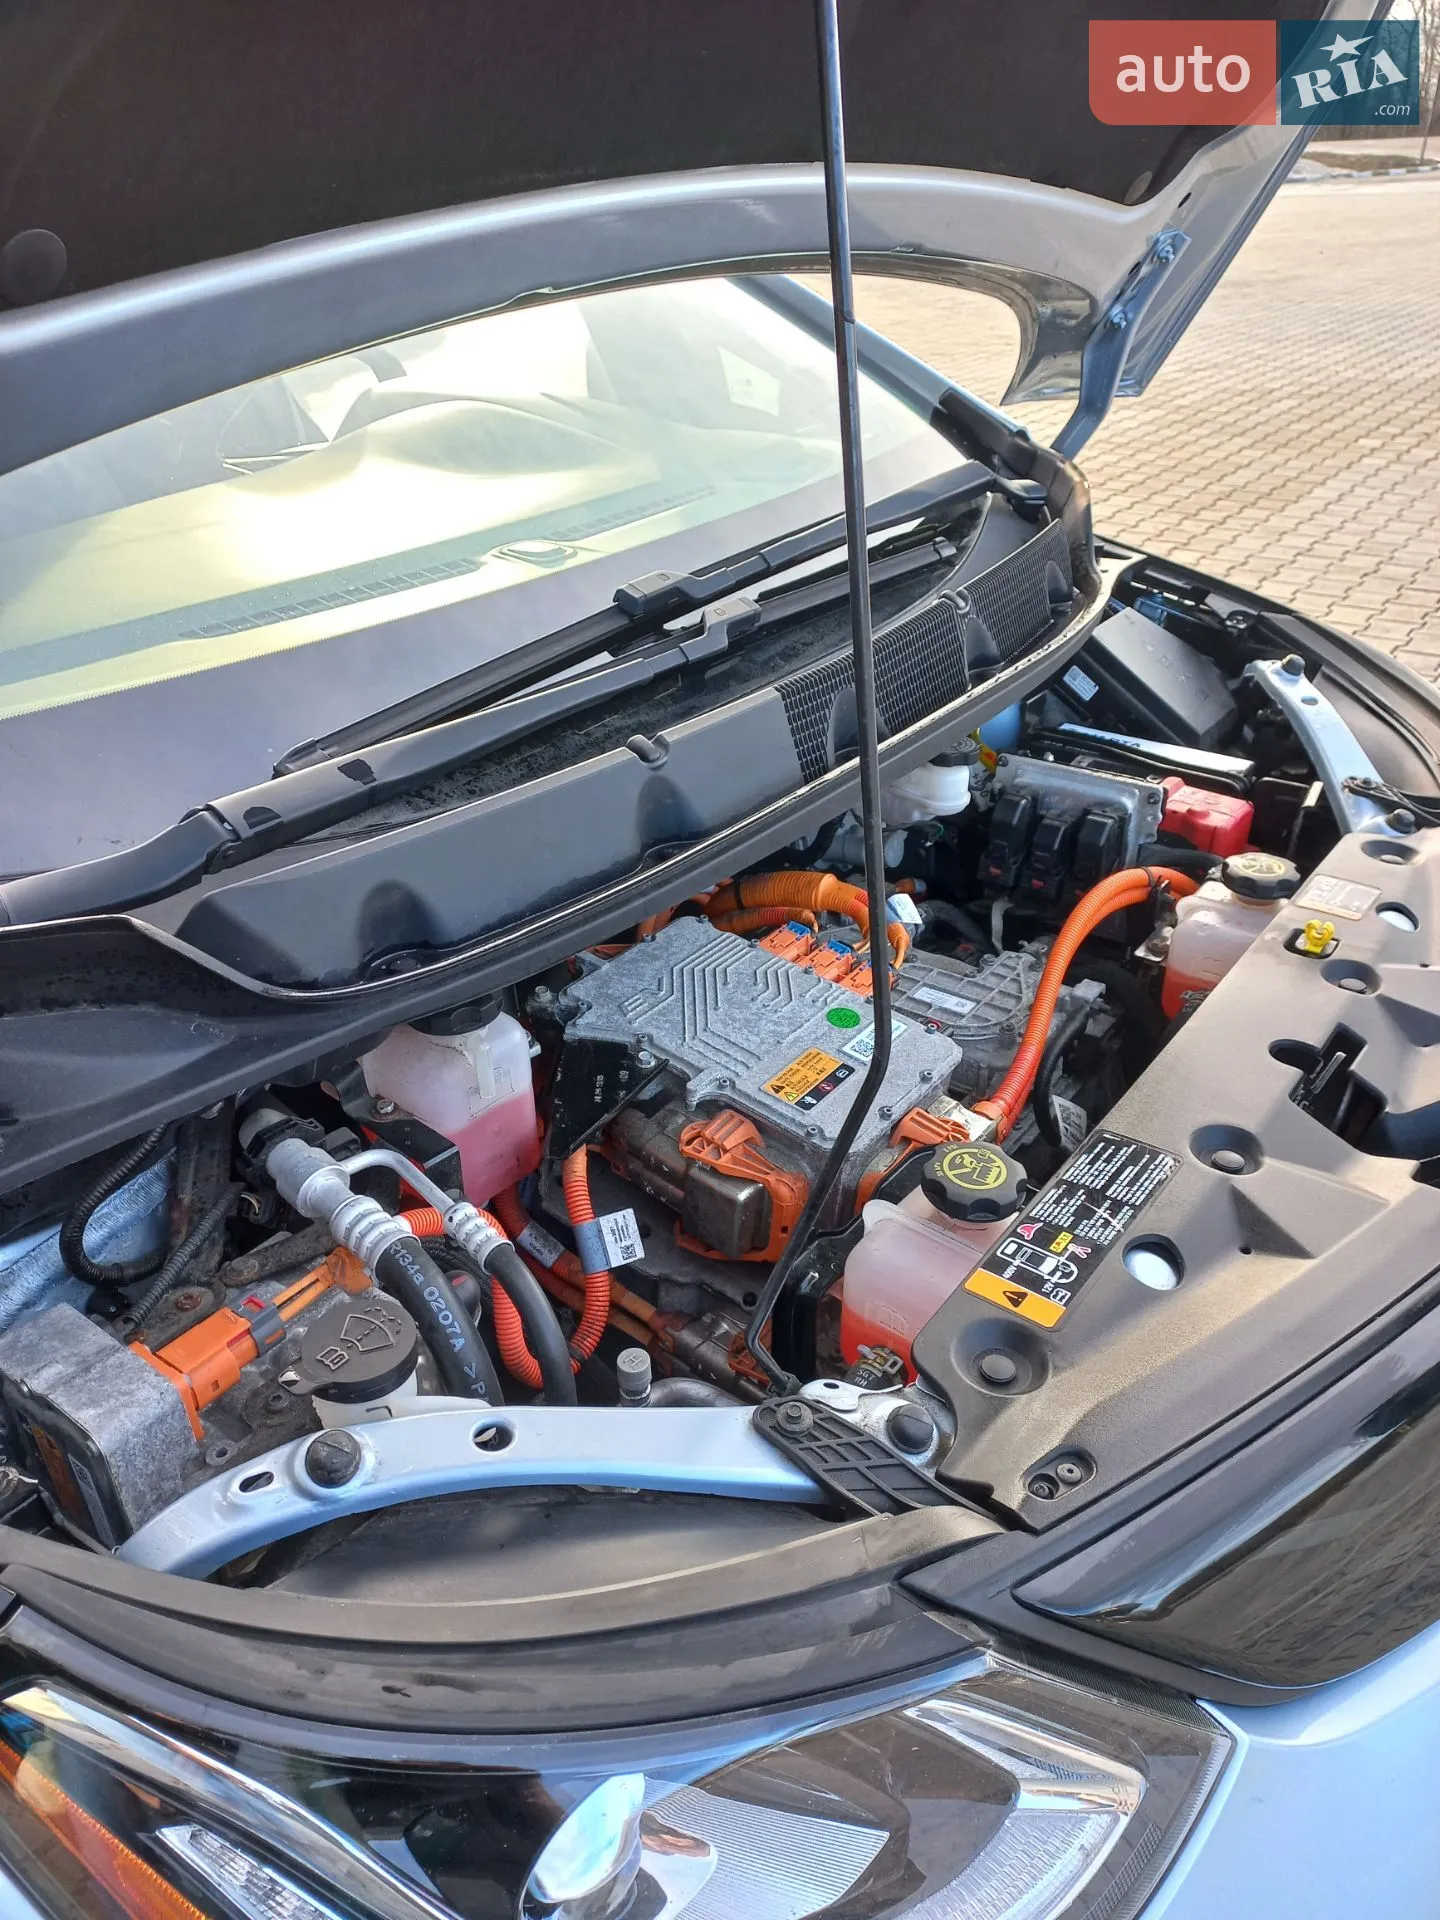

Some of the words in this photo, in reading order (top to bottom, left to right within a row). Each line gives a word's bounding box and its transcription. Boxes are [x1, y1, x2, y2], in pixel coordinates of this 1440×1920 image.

[390, 1243, 424, 1285] R134a
[423, 1286, 465, 1352] 0207A
[1042, 1281, 1054, 1293] 12V
